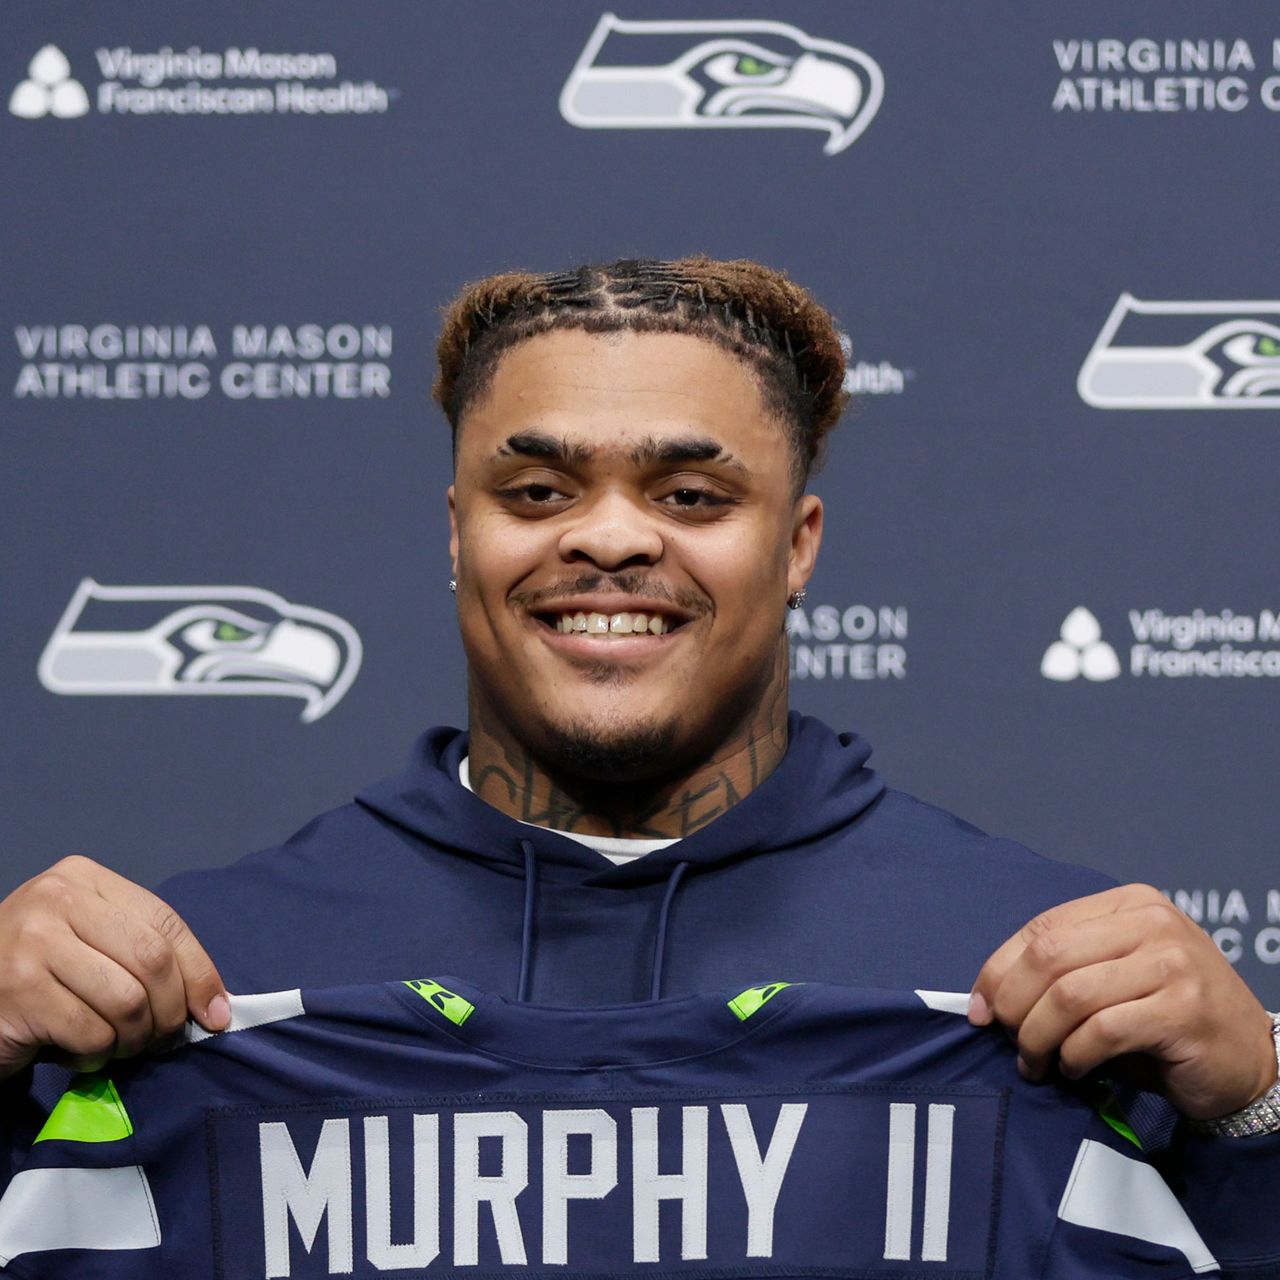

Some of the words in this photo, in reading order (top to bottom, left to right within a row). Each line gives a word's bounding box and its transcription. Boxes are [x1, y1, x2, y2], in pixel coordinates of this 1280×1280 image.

[95, 46, 223, 88] Virginia
[223, 46, 337, 80] Mason
[1053, 37, 1255, 73] VIRGINIA
[97, 80, 275, 114] Franciscan
[275, 80, 389, 114] Health
[1052, 76, 1249, 112] ATHLETIC
[15, 324, 217, 360] VIRGINIA
[232, 324, 393, 360] MASON
[15, 362, 210, 399] ATHLETIC
[220, 362, 391, 399] CENTER
[789, 605, 908, 641] ASON
[1128, 608, 1256, 650] Virginia
[258, 1102, 809, 1280] MURPHY
[883, 1102, 956, 1263] II
